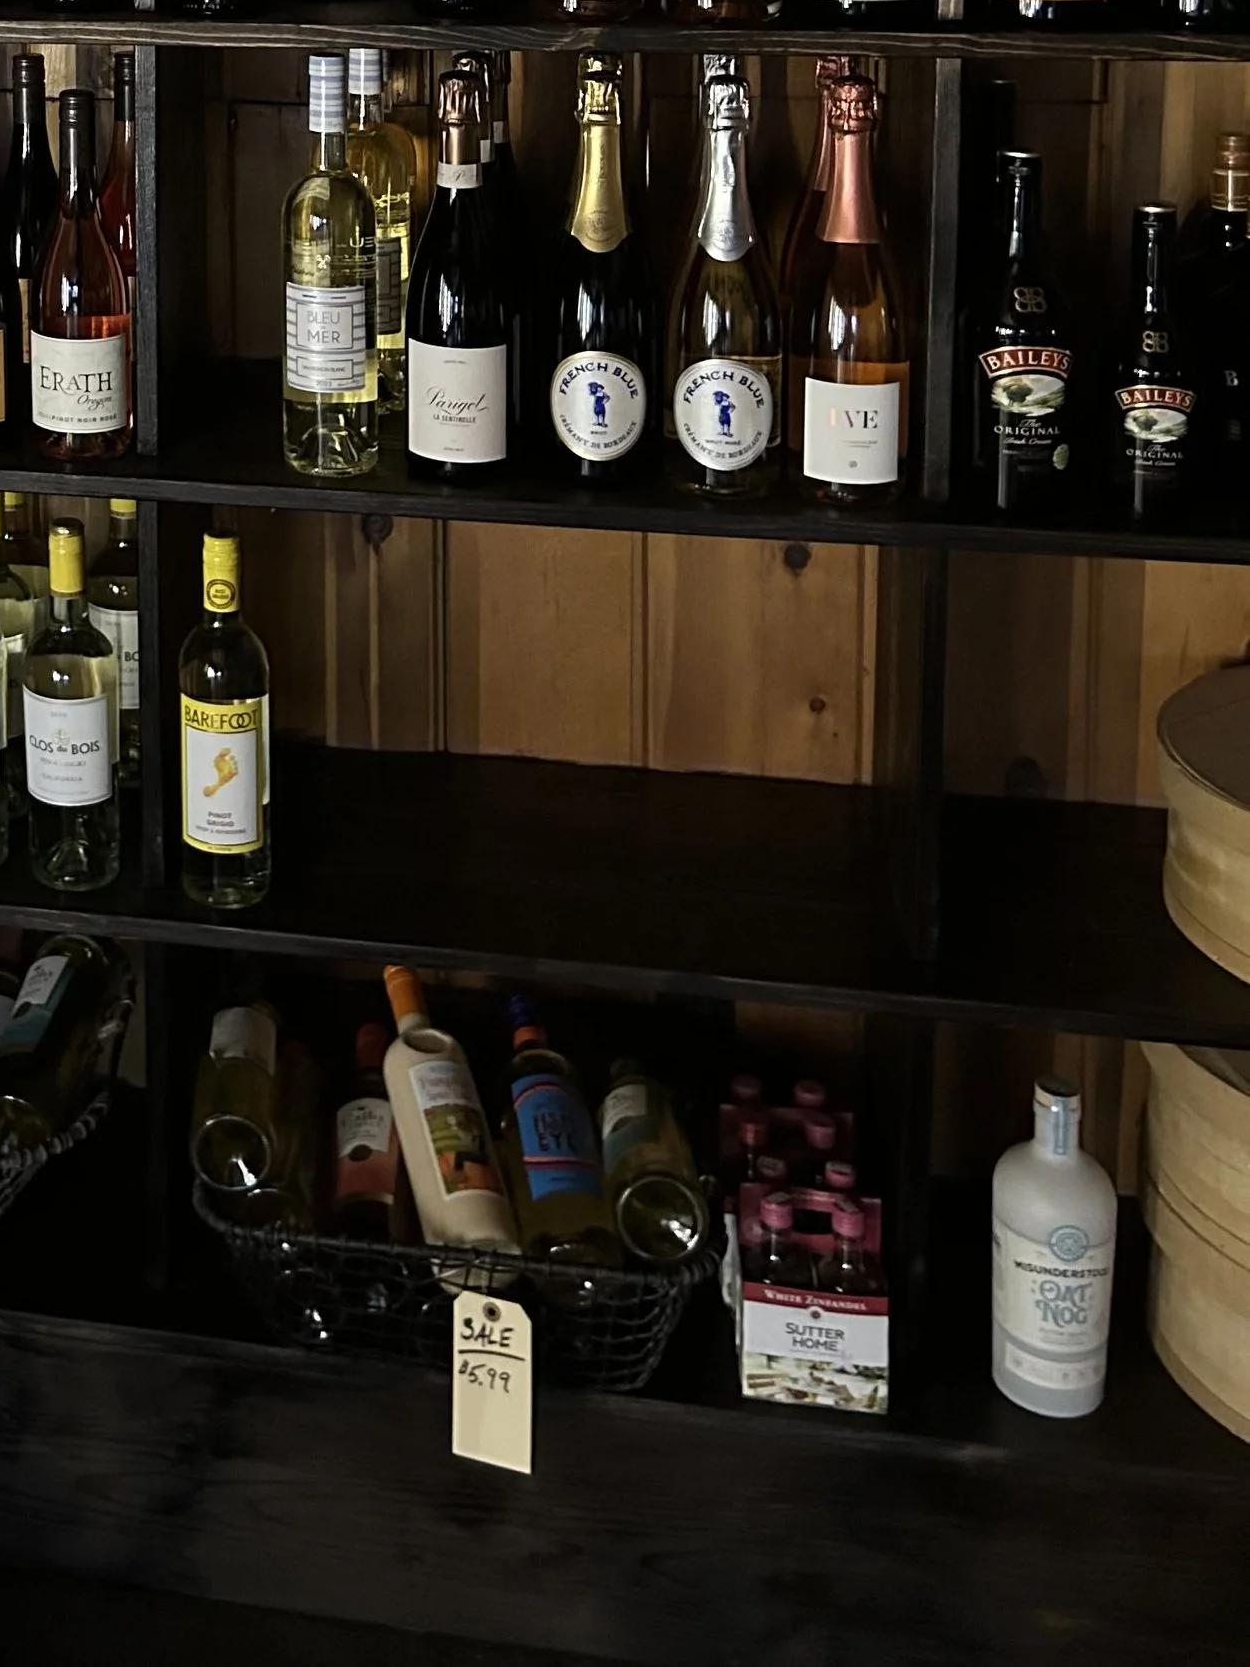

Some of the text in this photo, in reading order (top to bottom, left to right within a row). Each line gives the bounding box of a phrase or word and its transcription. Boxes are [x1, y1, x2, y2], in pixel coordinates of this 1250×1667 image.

[307, 310, 340, 325] BLEU
[307, 330, 341, 344] MER
[987, 350, 1072, 373] BAILEYS
[39, 365, 113, 393] ERATH
[559, 361, 640, 400] FRENCH BLUE
[683, 370, 765, 409] FRENCH BLUE
[1119, 390, 1194, 411] BAILEYS
[603, 420, 637, 450] BORDEAUX
[993, 424, 1061, 436] ORIGINAL
[728, 429, 763, 459] BORDEAUX
[1125, 448, 1184, 460] ORIGINAL
[184, 705, 258, 729] BAREFOOT
[29, 736, 54, 753] CLOS
[71, 740, 100, 755] BOIS
[208, 811, 233, 820] PINOT
[1014, 1260, 1110, 1279] MISUNDERSTOOD
[764, 1289, 867, 1312] WHITE ZINFANDEL
[1038, 1279, 1093, 1304] OAT
[1035, 1299, 1089, 1328] NOG
[461, 1317, 514, 1348] SALE
[785, 1323, 845, 1341] SUTTER
[792, 1336, 839, 1352] HOME
[458, 1359, 510, 1394] $5.99
